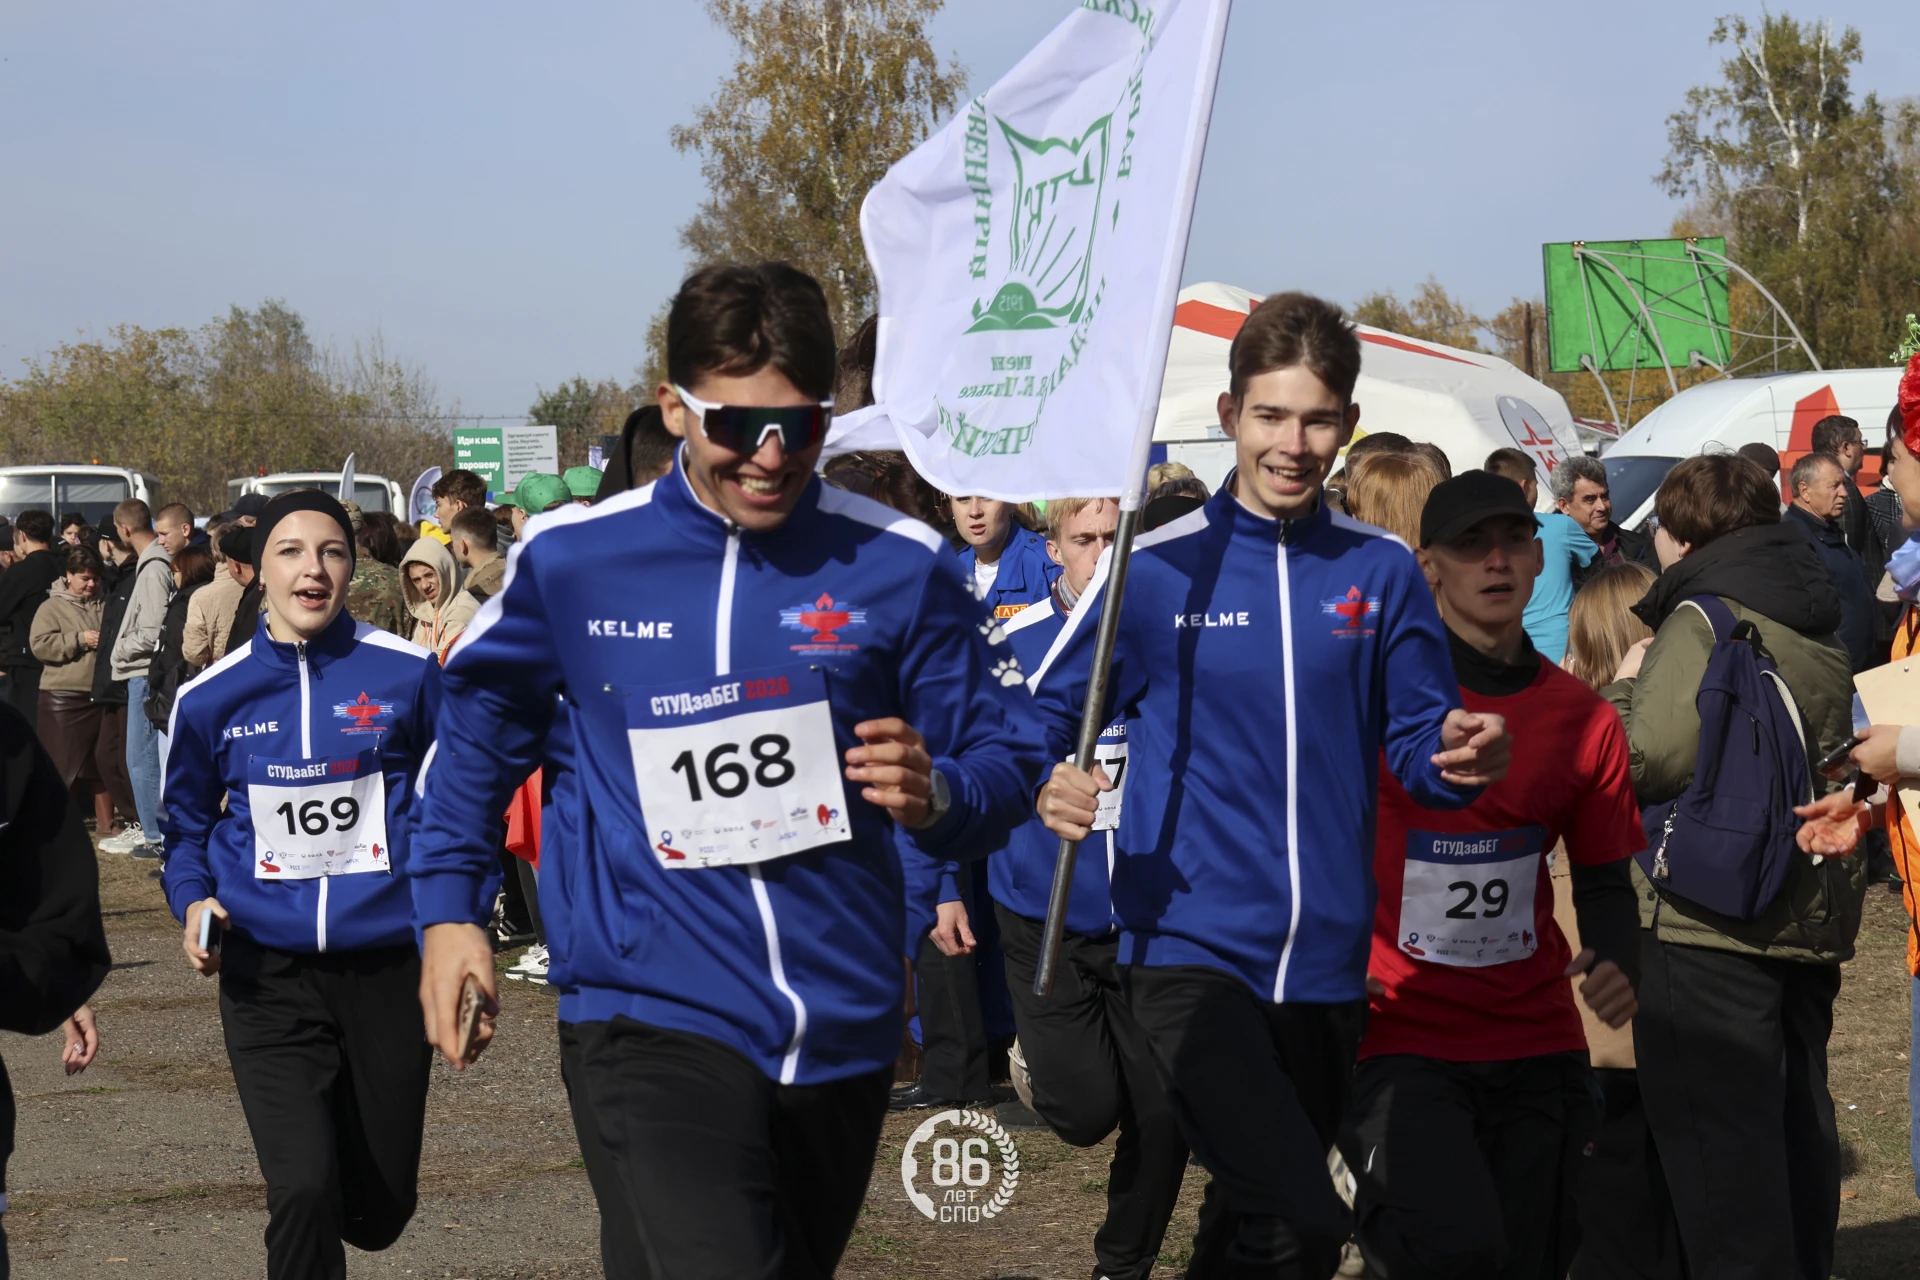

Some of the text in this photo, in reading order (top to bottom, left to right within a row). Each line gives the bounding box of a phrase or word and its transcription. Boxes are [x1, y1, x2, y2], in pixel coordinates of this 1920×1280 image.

[457, 435, 501, 446] Иди к нам,
[457, 449, 472, 457] мы
[458, 461, 501, 472] хорошему
[587, 619, 673, 638] KELME
[1174, 611, 1250, 628] KELME
[650, 676, 790, 716] СТУДзаБЕГ 2026
[223, 720, 279, 740] KELME
[267, 763, 328, 780] СТУДзаБЕГ
[671, 733, 796, 802] 168
[276, 796, 360, 836] 169
[1432, 839, 1499, 857] СТУДзаБЕГ
[1445, 878, 1509, 920] 29
